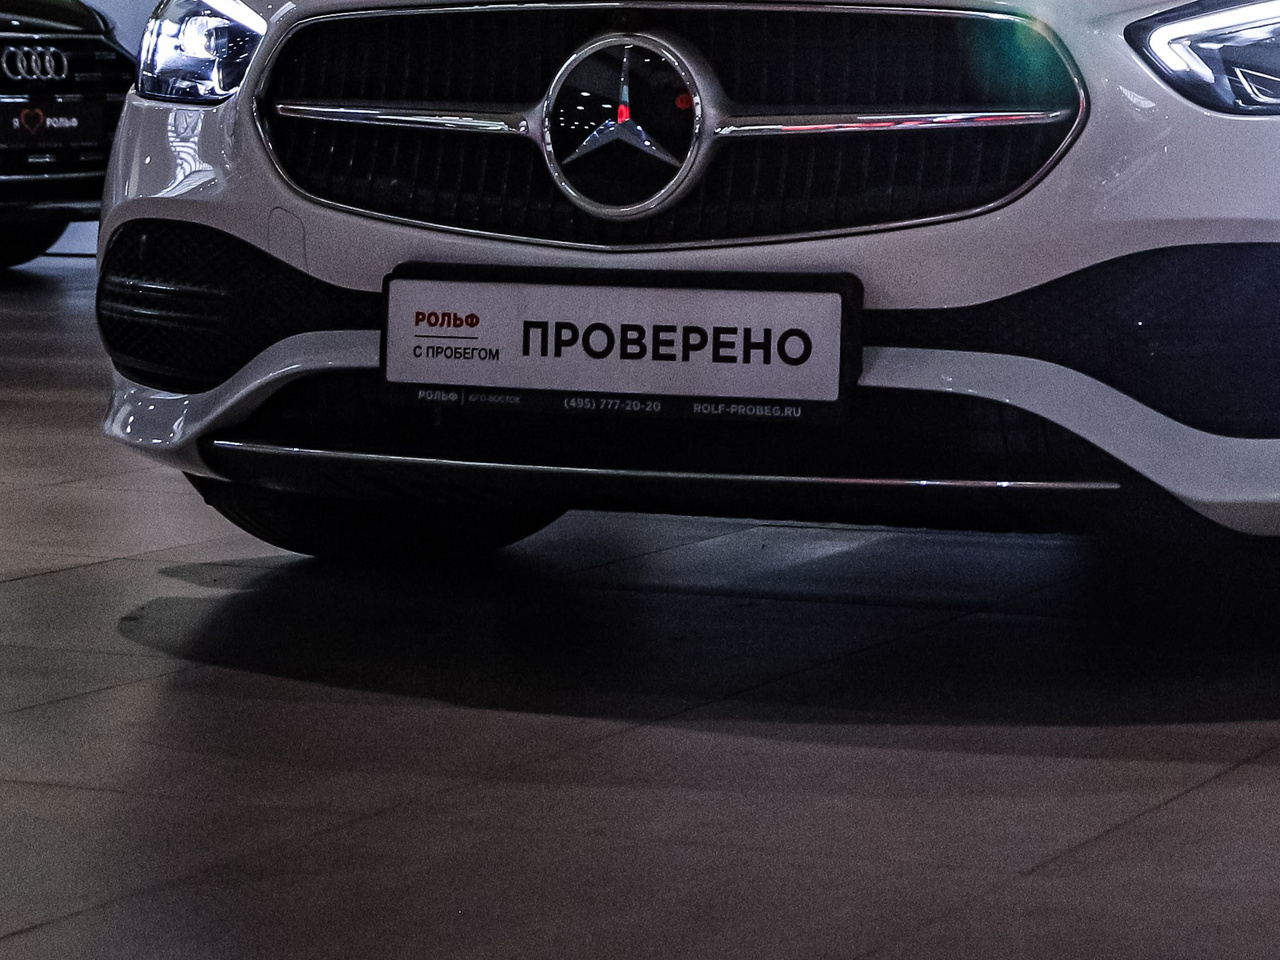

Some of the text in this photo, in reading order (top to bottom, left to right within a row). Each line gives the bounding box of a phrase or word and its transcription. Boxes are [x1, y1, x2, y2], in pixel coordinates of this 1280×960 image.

[414, 311, 480, 328] РОЛЬФ
[521, 320, 813, 366] ПРОВЕРЕНО
[413, 345, 500, 361] С ПРОБЕГОМ
[417, 389, 458, 401] РОЛЬФ
[563, 398, 661, 413] (495) 777-20-20
[693, 402, 802, 418] ROLF-PROBEG.RU
